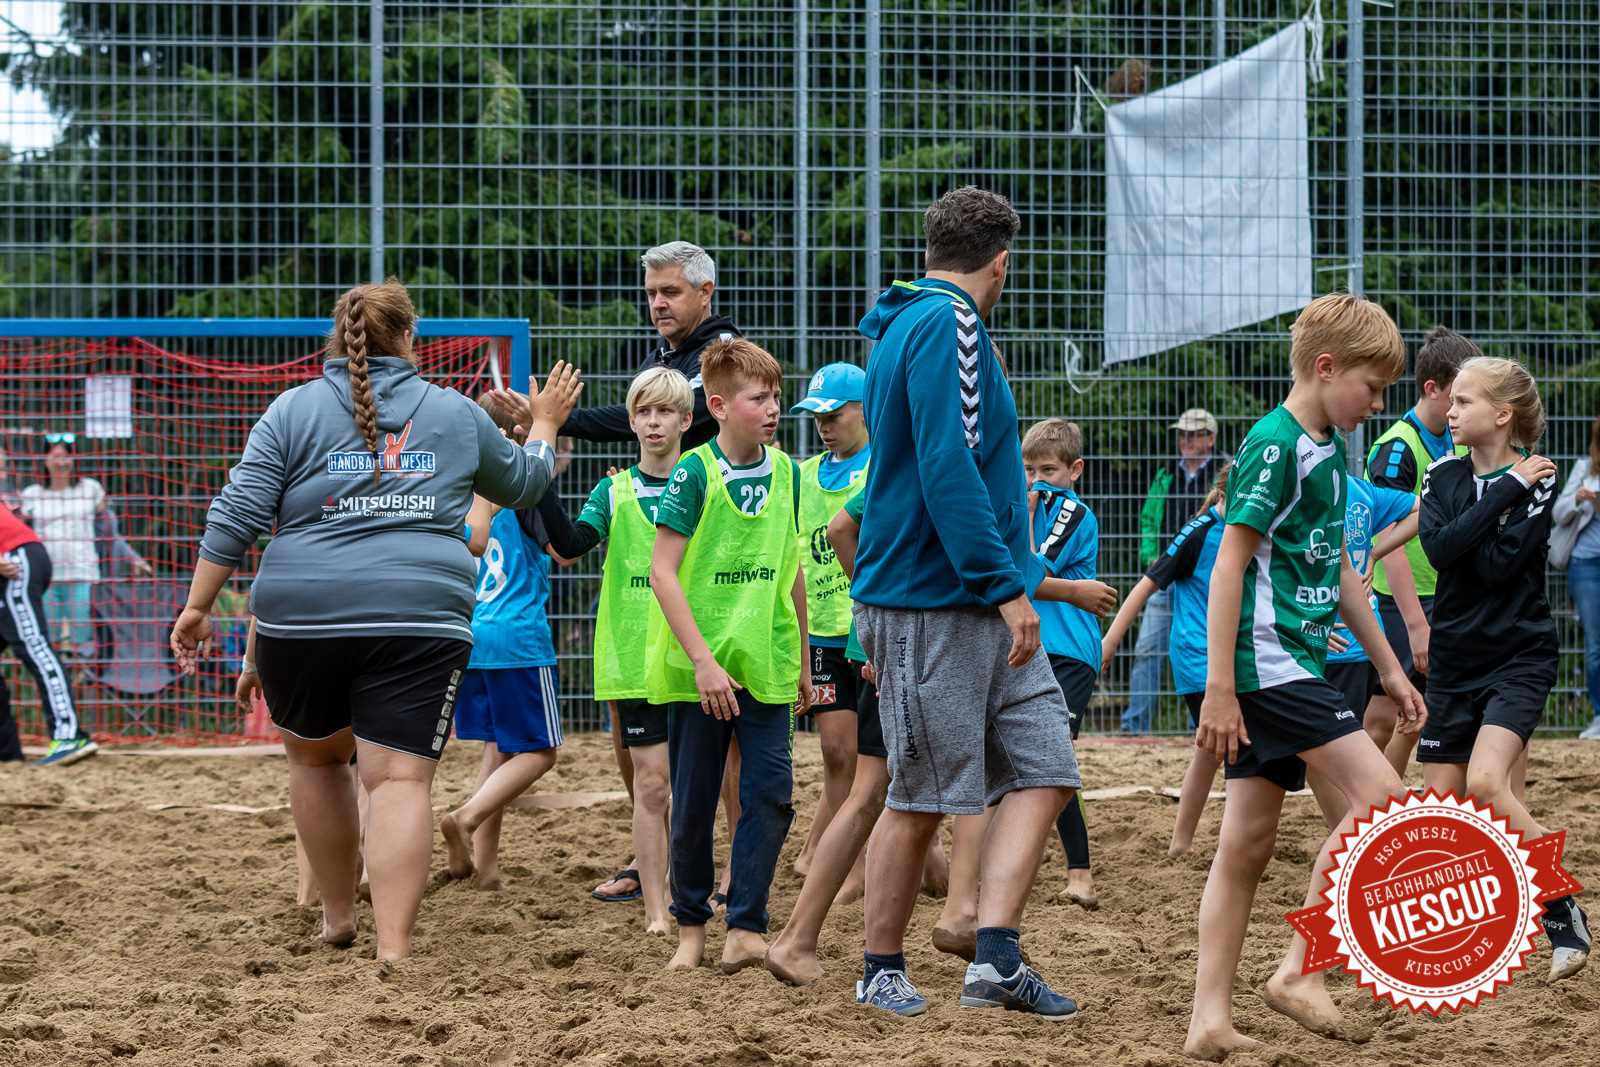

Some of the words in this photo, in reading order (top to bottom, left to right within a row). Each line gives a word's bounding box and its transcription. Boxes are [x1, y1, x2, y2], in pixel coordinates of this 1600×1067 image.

[386, 454, 397, 469] IN
[400, 454, 433, 469] WESEL
[339, 494, 436, 511] MITSUBISHI
[741, 484, 768, 517] 22
[363, 509, 434, 520] Cramer-Schmitz
[815, 574, 834, 587] Wir
[901, 688, 919, 760] Abercrombie
[1019, 977, 1043, 1007] N
